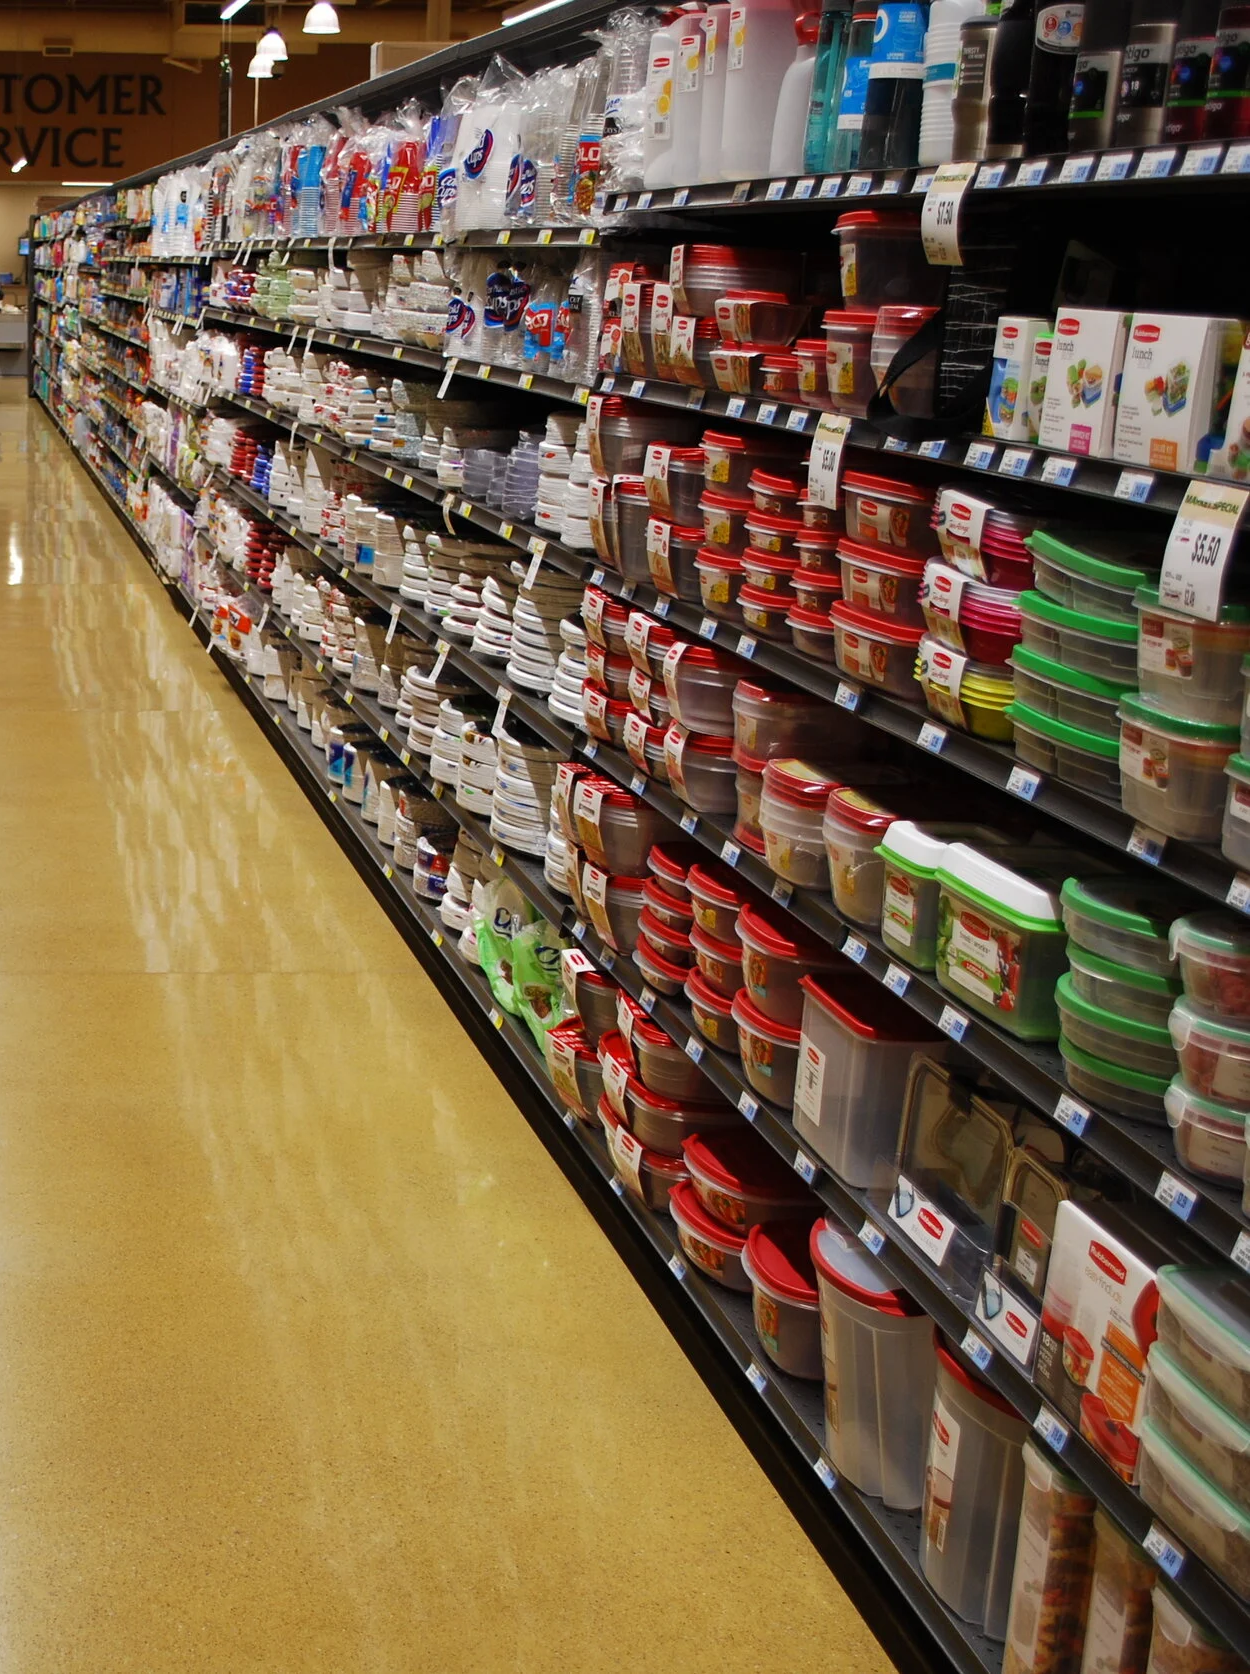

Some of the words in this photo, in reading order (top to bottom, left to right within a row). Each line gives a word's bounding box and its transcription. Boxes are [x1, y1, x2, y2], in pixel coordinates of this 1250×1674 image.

[1130, 80, 1140, 90] 18
[1191, 532, 1221, 567] $5.50
[1090, 1246, 1126, 1281] Rubbermaid
